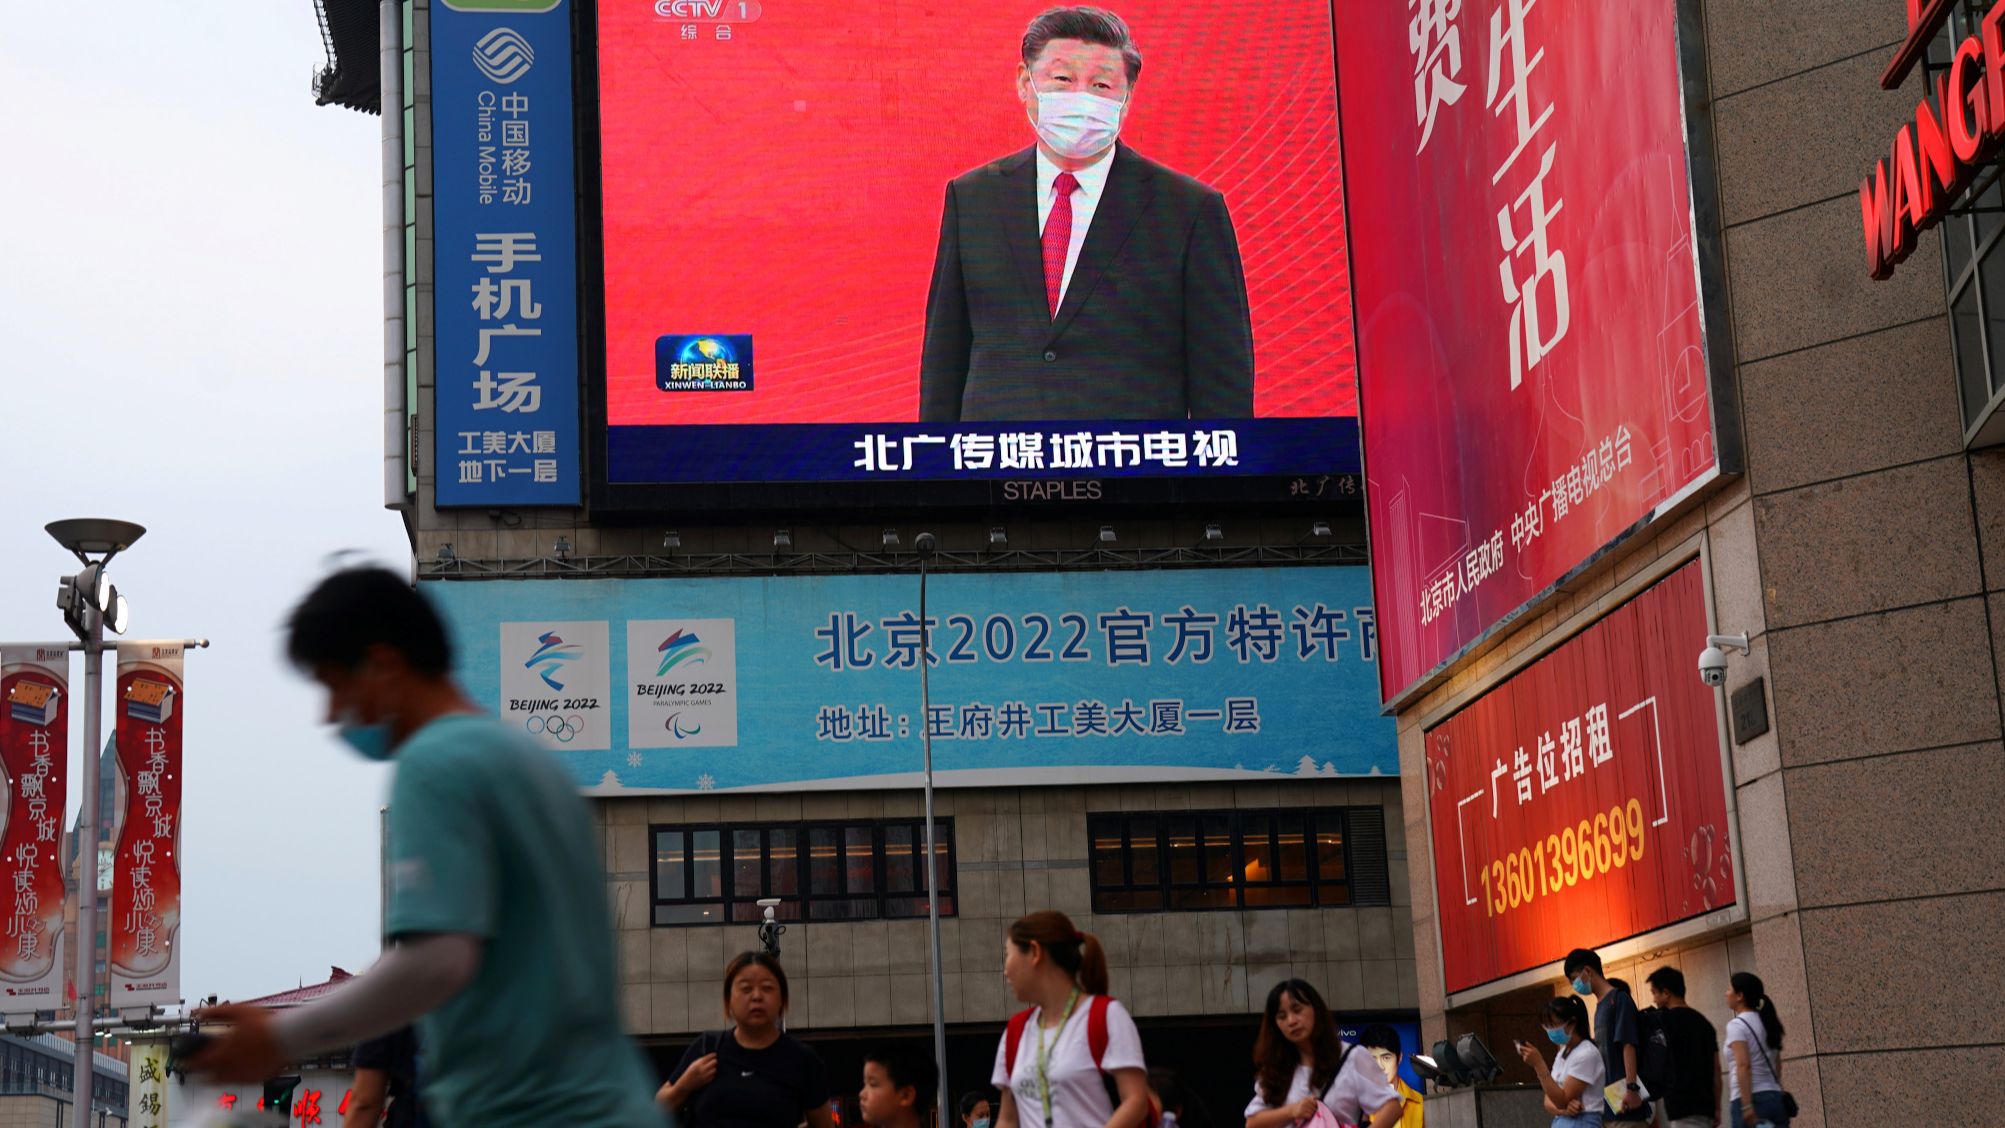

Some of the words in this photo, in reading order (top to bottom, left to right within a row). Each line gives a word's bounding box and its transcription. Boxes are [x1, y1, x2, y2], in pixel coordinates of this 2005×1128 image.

[654, 0, 722, 18] CCTV
[738, 2, 747, 19] 1
[681, 24, 731, 40] 综合
[478, 91, 496, 142] China
[502, 91, 531, 205] 中国移动
[479, 146, 497, 204] Mobile
[1486, 0, 1570, 391] 生活
[471, 232, 541, 413] 手机广场
[670, 363, 739, 380] 新闻联播
[665, 381, 704, 390] XINWEN
[458, 431, 555, 454] 工美大厦
[853, 430, 1239, 471] 北广传媒城市电视
[458, 459, 557, 483] 地下一层
[1004, 481, 1101, 500] STAPLES
[1290, 475, 1363, 496] 北广传
[1420, 529, 1504, 626] 北京市人民政府
[1511, 425, 1632, 553] 中央广播电视总台
[637, 684, 685, 699] BEIJING
[690, 683, 726, 694] 2022
[510, 699, 559, 714] BEIJING
[563, 698, 600, 710] 2022
[1491, 702, 1613, 819] 广告位招租
[1481, 798, 1645, 917] 13601396699
